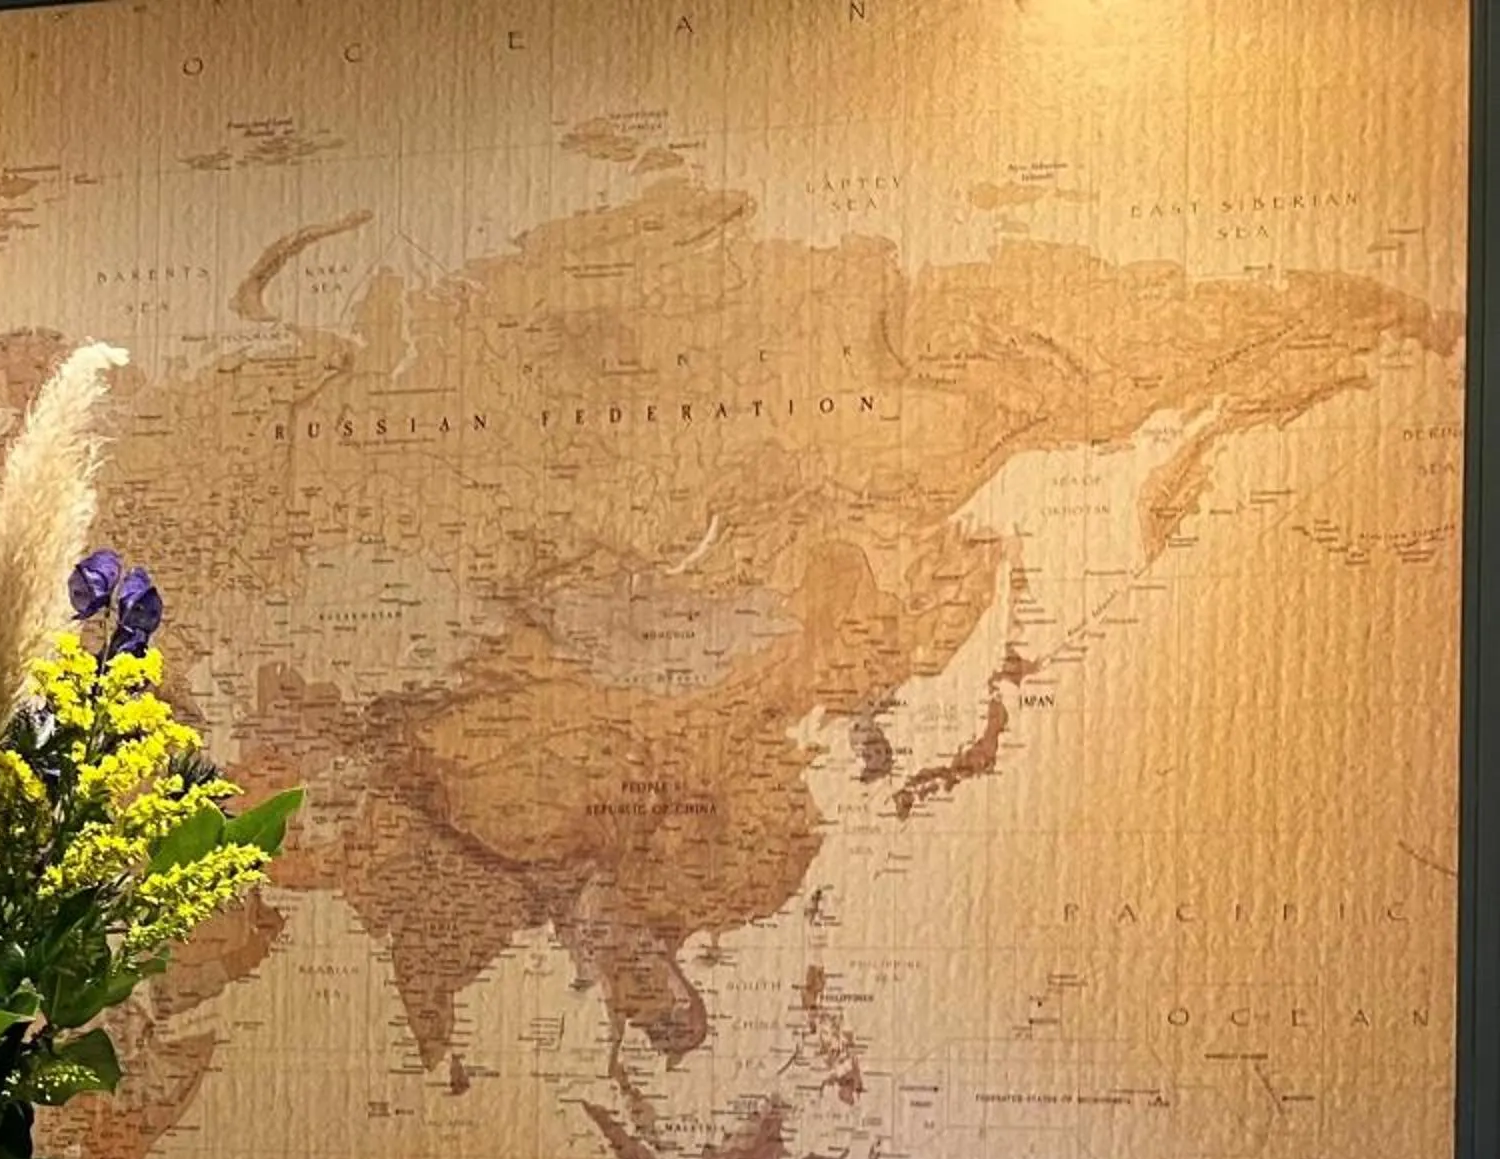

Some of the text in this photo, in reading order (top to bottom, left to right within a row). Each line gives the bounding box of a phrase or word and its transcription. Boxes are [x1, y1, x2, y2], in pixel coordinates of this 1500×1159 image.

[274, 395, 875, 440] RUSSIAN FEDERATION
[1018, 694, 1055, 711] JAPAN
[1063, 902, 1409, 922] PACIFIC
[1167, 1008, 1430, 1028] OCEAN
